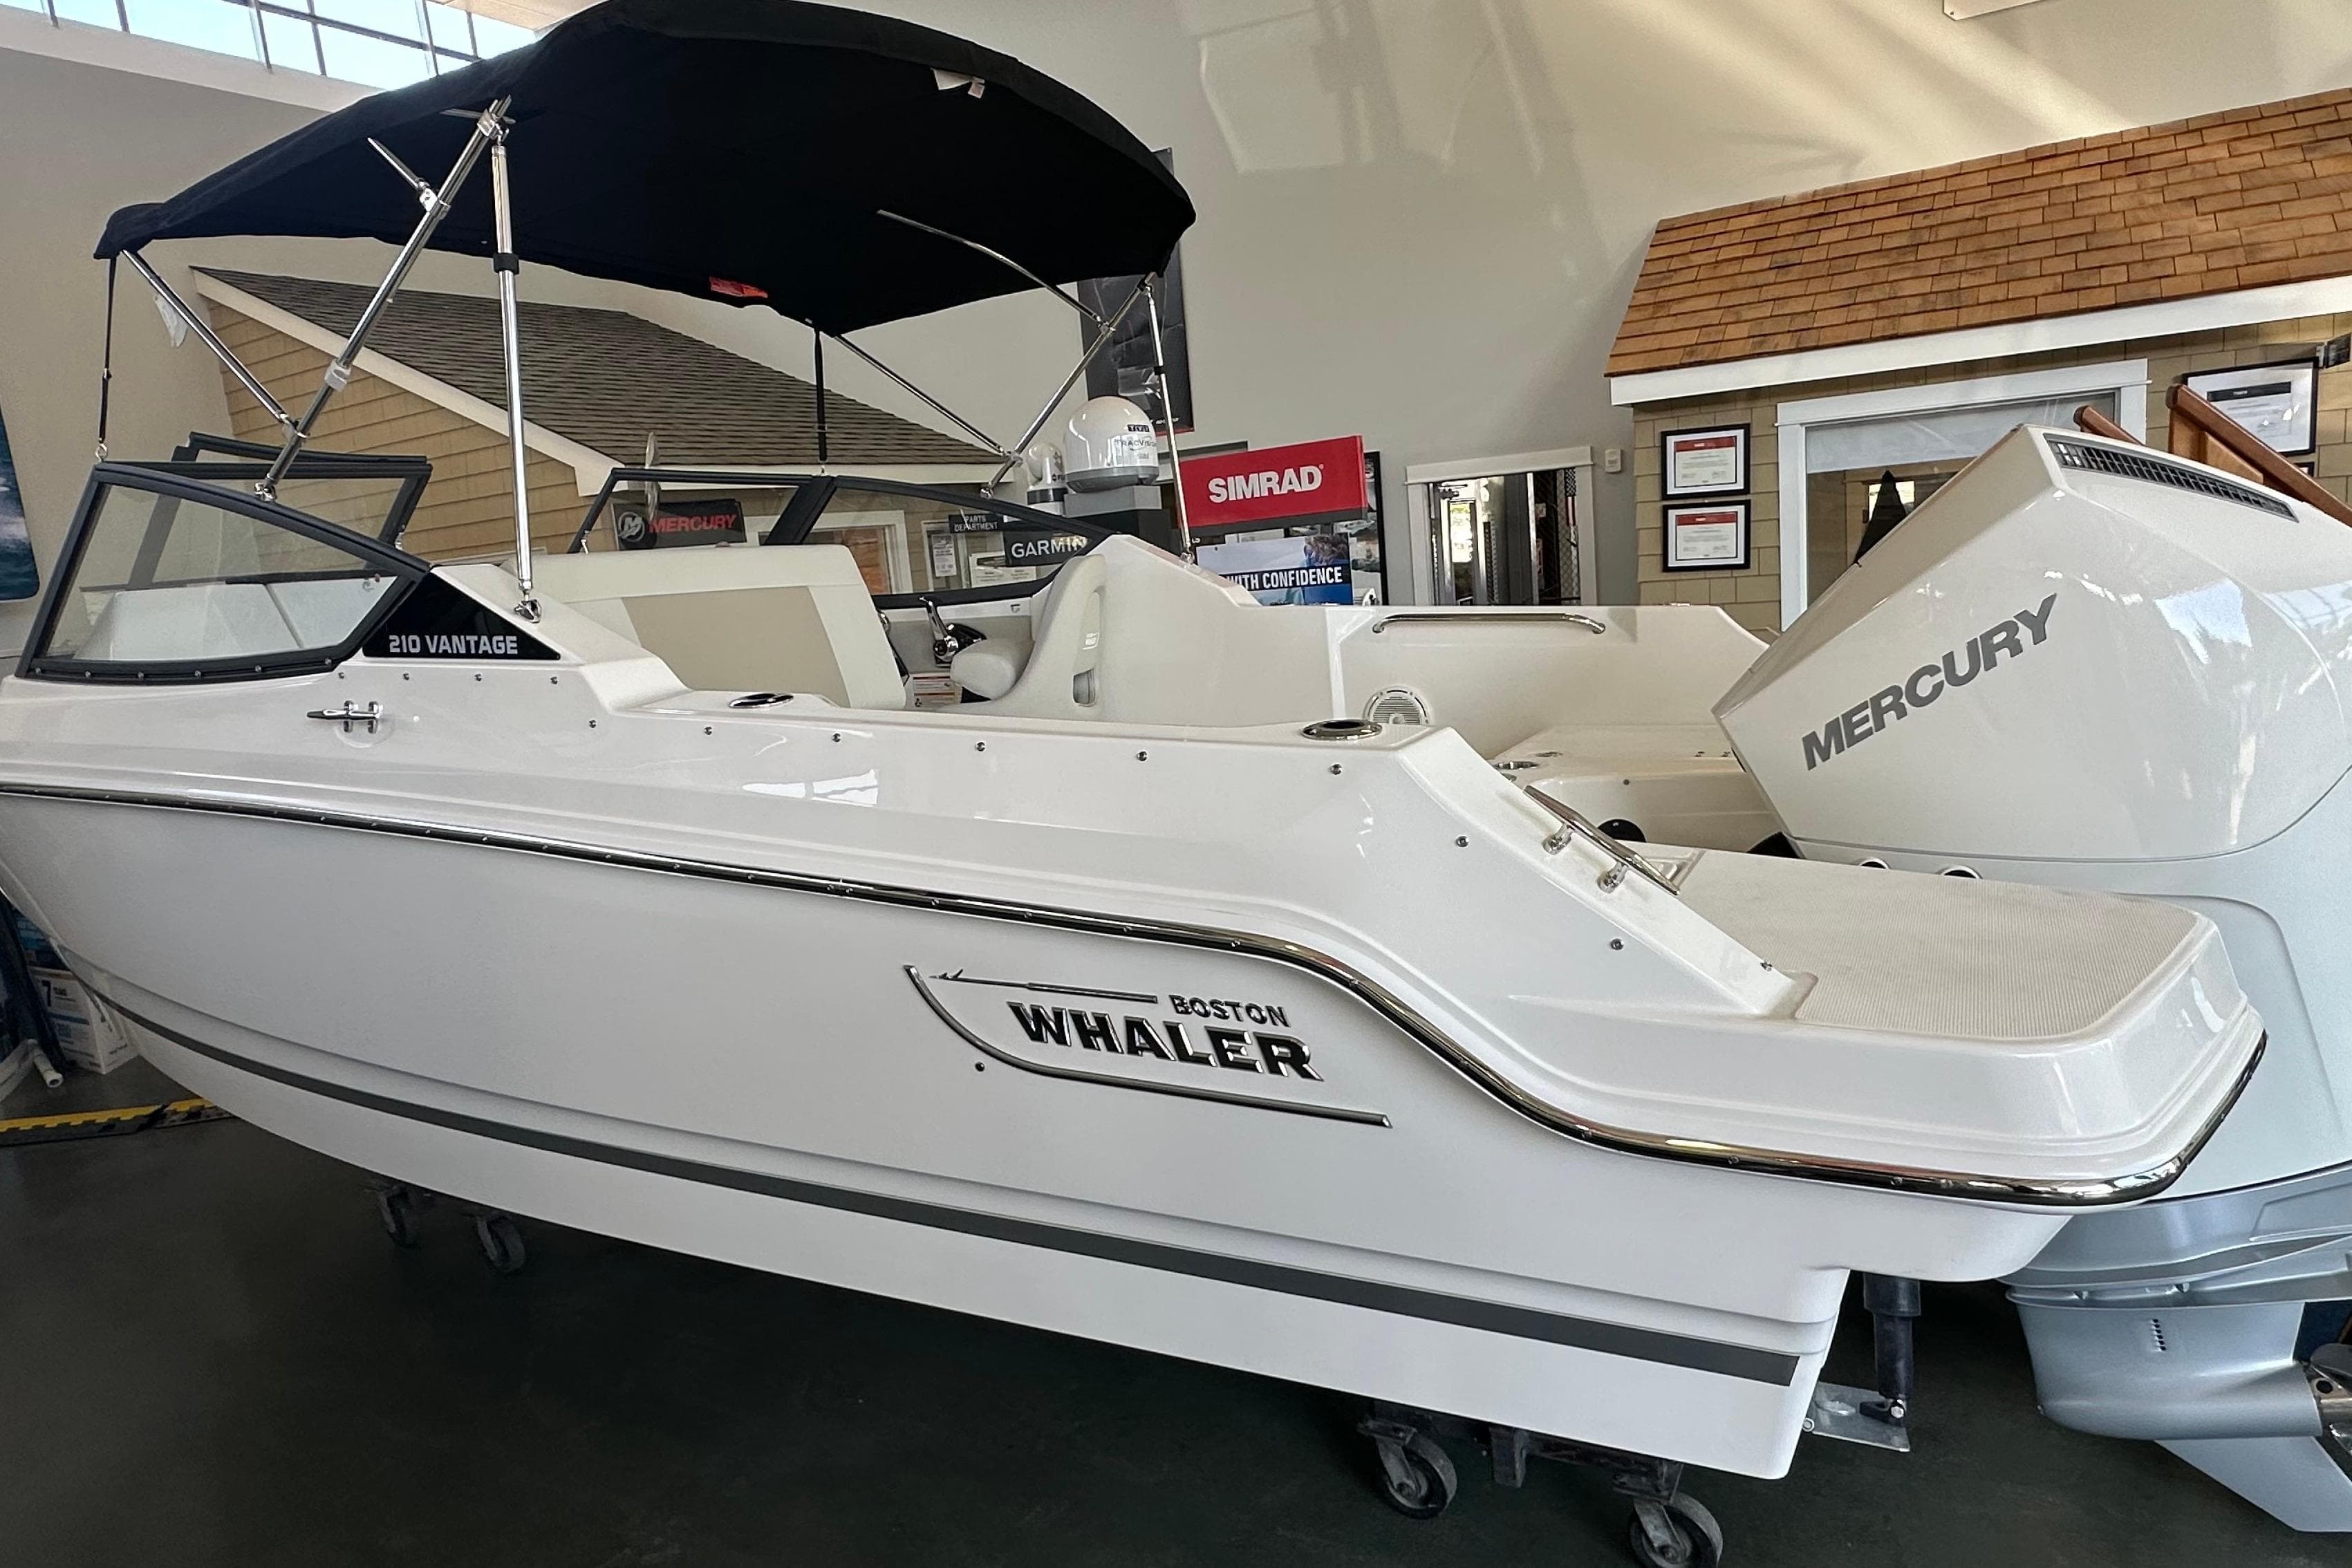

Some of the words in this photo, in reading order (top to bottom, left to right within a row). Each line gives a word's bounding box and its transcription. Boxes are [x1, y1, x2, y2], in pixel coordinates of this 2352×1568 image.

[1208, 465, 1323, 503] SIMRAD
[648, 514, 737, 533] MERCURY
[953, 521, 998, 532] DEPARTMENT
[964, 514, 987, 523] PARTS
[1011, 536, 1086, 559] GARMIN
[1262, 566, 1343, 589] CONFIDENCE
[389, 635, 421, 653] 210
[424, 635, 519, 655] VANTAGE
[1802, 592, 2057, 772] MERCURY
[1168, 994, 1291, 1027] BOSTON
[1007, 1001, 1325, 1082] WHALER
